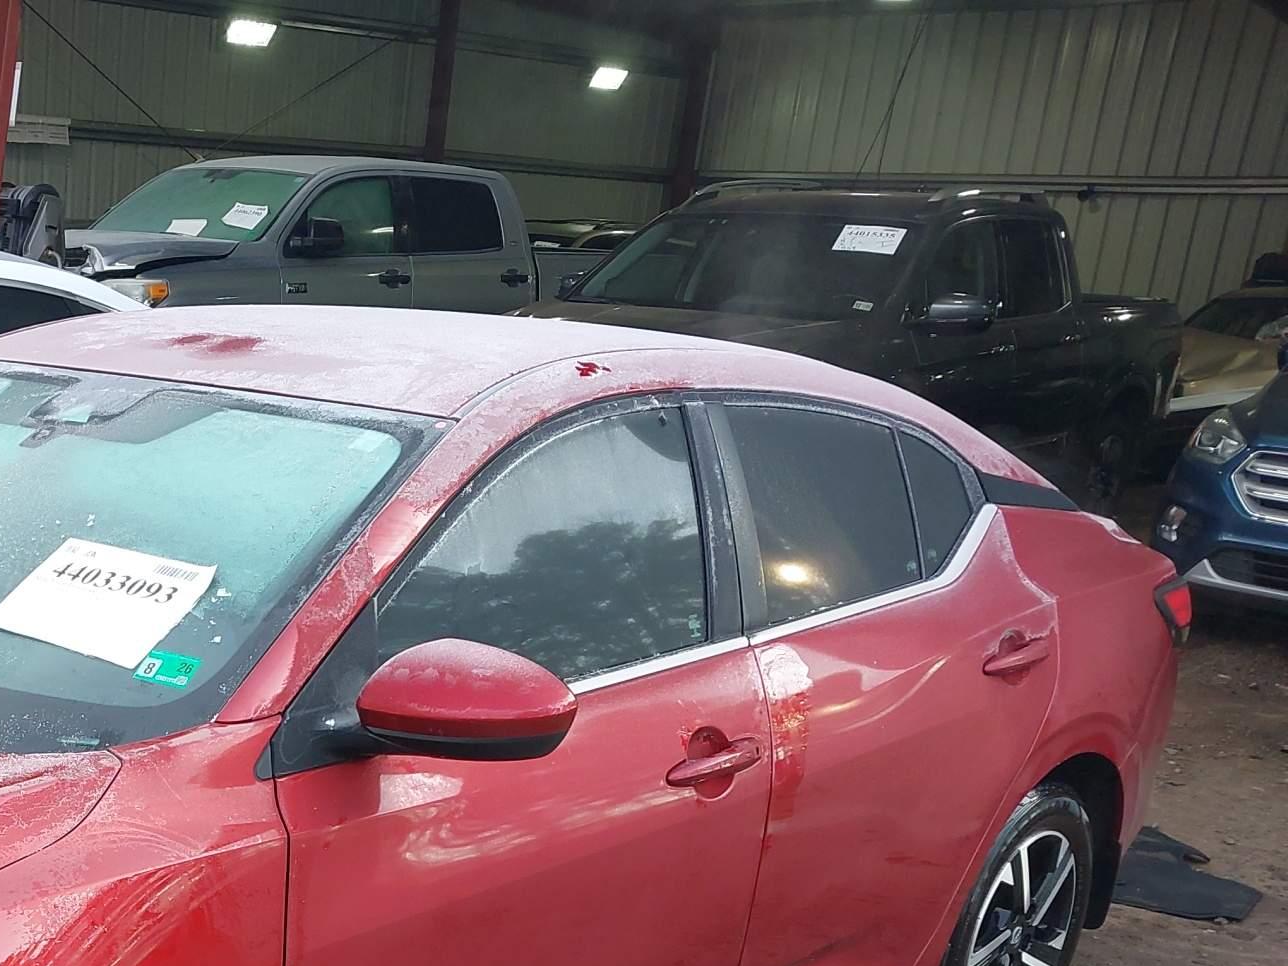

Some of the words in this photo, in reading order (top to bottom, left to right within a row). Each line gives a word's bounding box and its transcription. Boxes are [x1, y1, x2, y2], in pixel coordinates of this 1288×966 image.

[52, 562, 179, 604] 44033093
[143, 662, 156, 675] 8
[176, 662, 195, 675] 26
